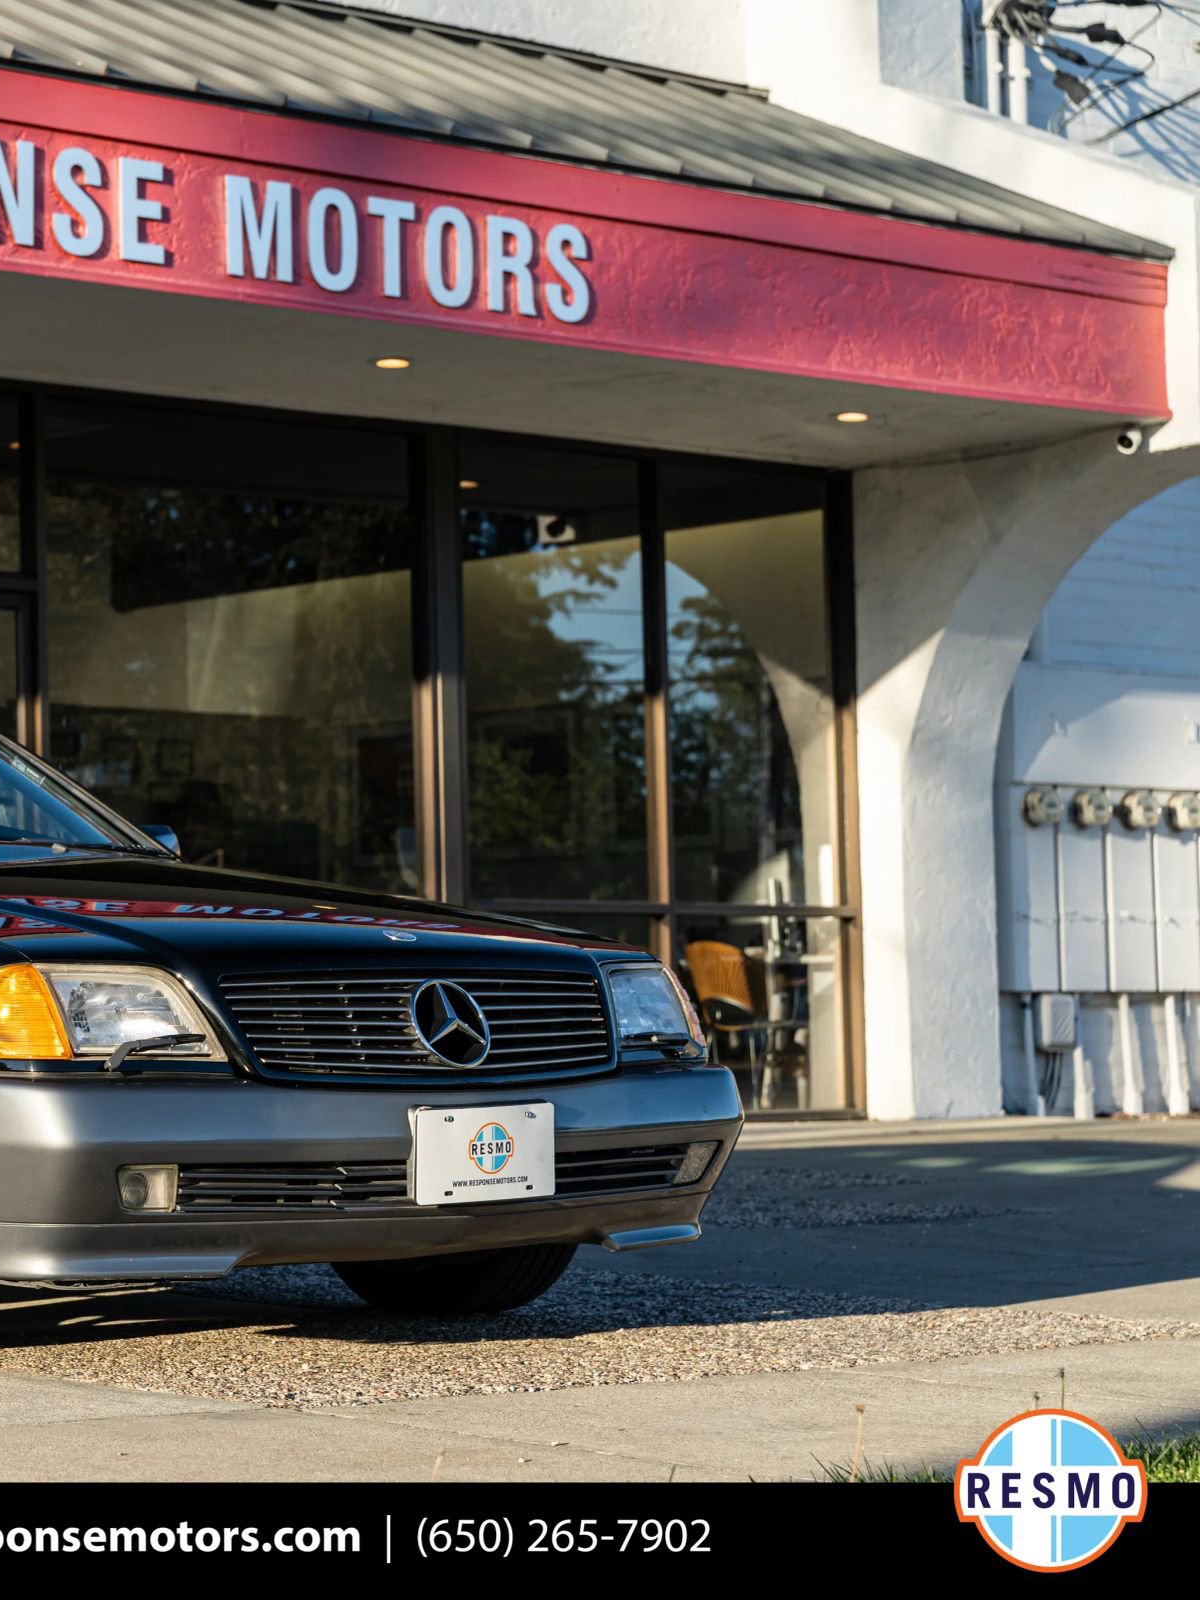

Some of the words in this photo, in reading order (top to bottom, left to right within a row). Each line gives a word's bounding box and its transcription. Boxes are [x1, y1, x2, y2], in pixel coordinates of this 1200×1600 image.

[224, 174, 591, 324] MOTORS
[471, 1141, 512, 1156] RESMO
[452, 1176, 529, 1188] WWW.RESPONSEMOTORS.COM
